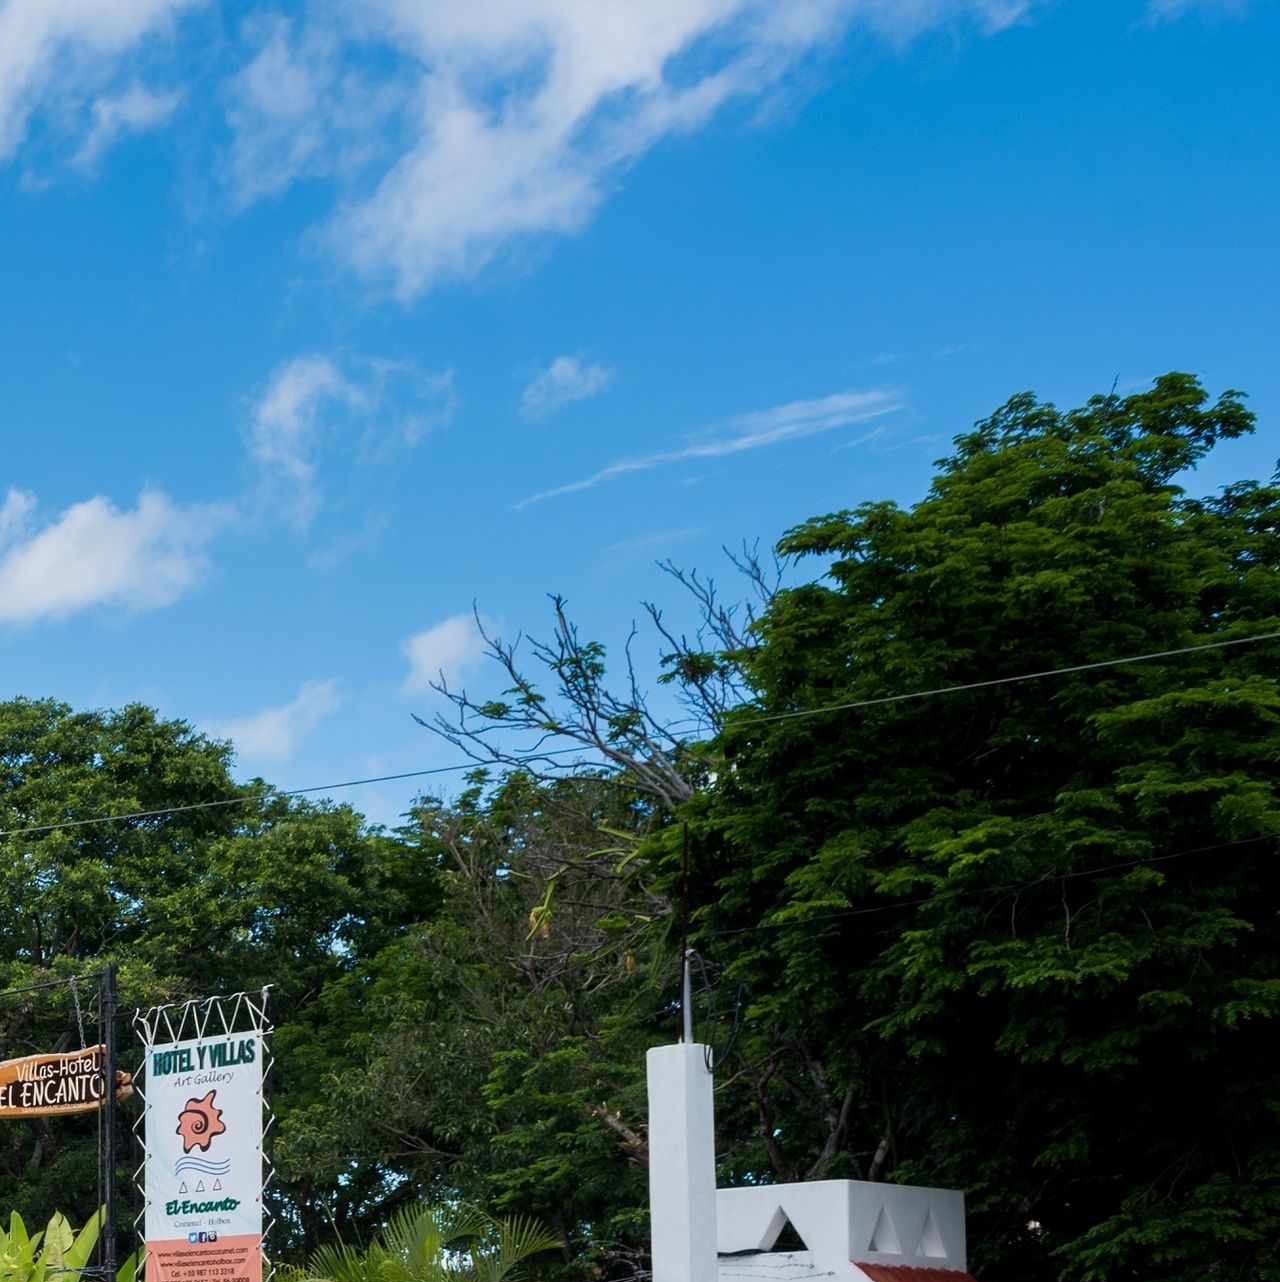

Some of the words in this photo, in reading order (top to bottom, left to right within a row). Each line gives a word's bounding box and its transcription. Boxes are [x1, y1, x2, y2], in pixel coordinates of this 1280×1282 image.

[15, 1052, 100, 1083] Villas-Hotel
[153, 1047, 195, 1077] HOTEL
[196, 1045, 208, 1070] Y
[208, 1038, 256, 1068] VILLAS
[20, 1074, 105, 1108] ENCANTO
[174, 1077, 192, 1088] Art
[193, 1071, 234, 1085] Gallery
[165, 1200, 181, 1216] El
[181, 1197, 241, 1214] Encanto
